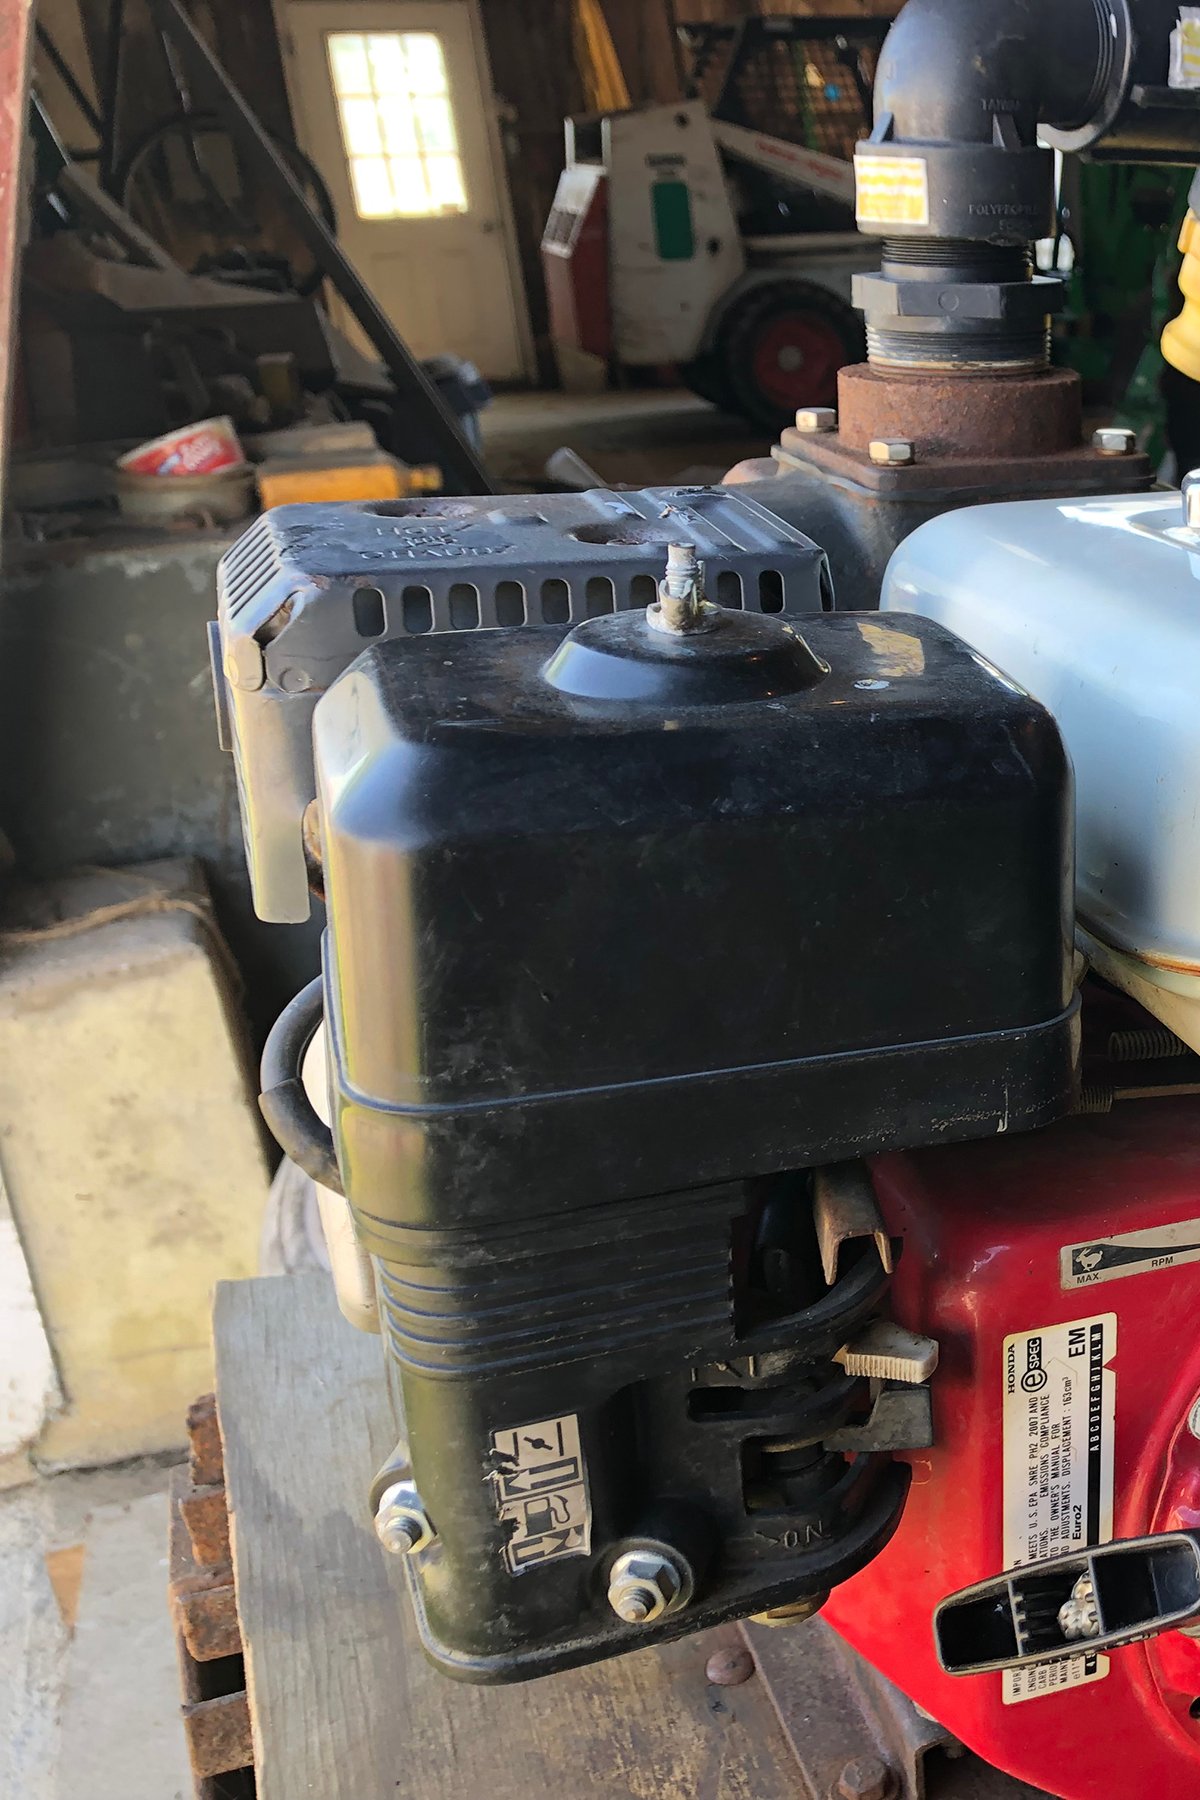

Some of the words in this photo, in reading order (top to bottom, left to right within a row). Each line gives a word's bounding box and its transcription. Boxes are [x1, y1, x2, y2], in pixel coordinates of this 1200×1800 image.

[1151, 1256, 1174, 1268] RPM
[1076, 1272, 1102, 1284] MAX.
[1028, 1338, 1040, 1369] SPEC
[1068, 1327, 1086, 1358] EM
[1007, 1343, 1016, 1395] HONDA
[1028, 1396, 1039, 1414] AND
[1028, 1415, 1039, 1437] 2007
[1040, 1394, 1050, 1448] COMPLIANCE
[1051, 1422, 1061, 1440] FOR
[1028, 1443, 1039, 1460] PH2
[1061, 1415, 1072, 1476] DISPLACEMENT
[1028, 1464, 1039, 1486] SNRE
[1050, 1445, 1061, 1479] MANUAL
[1039, 1454, 1050, 1498] EMISSIONS
[1028, 1491, 1039, 1508] EPA
[1050, 1484, 1060, 1521] OWNER'S
[1061, 1481, 1071, 1540] ADJUSTMENTS.
[1050, 1526, 1060, 1541] THE
[1072, 1504, 1082, 1540] Euro2
[1028, 1533, 1039, 1560] MEETS
[1038, 1669, 1047, 1689] CARB
